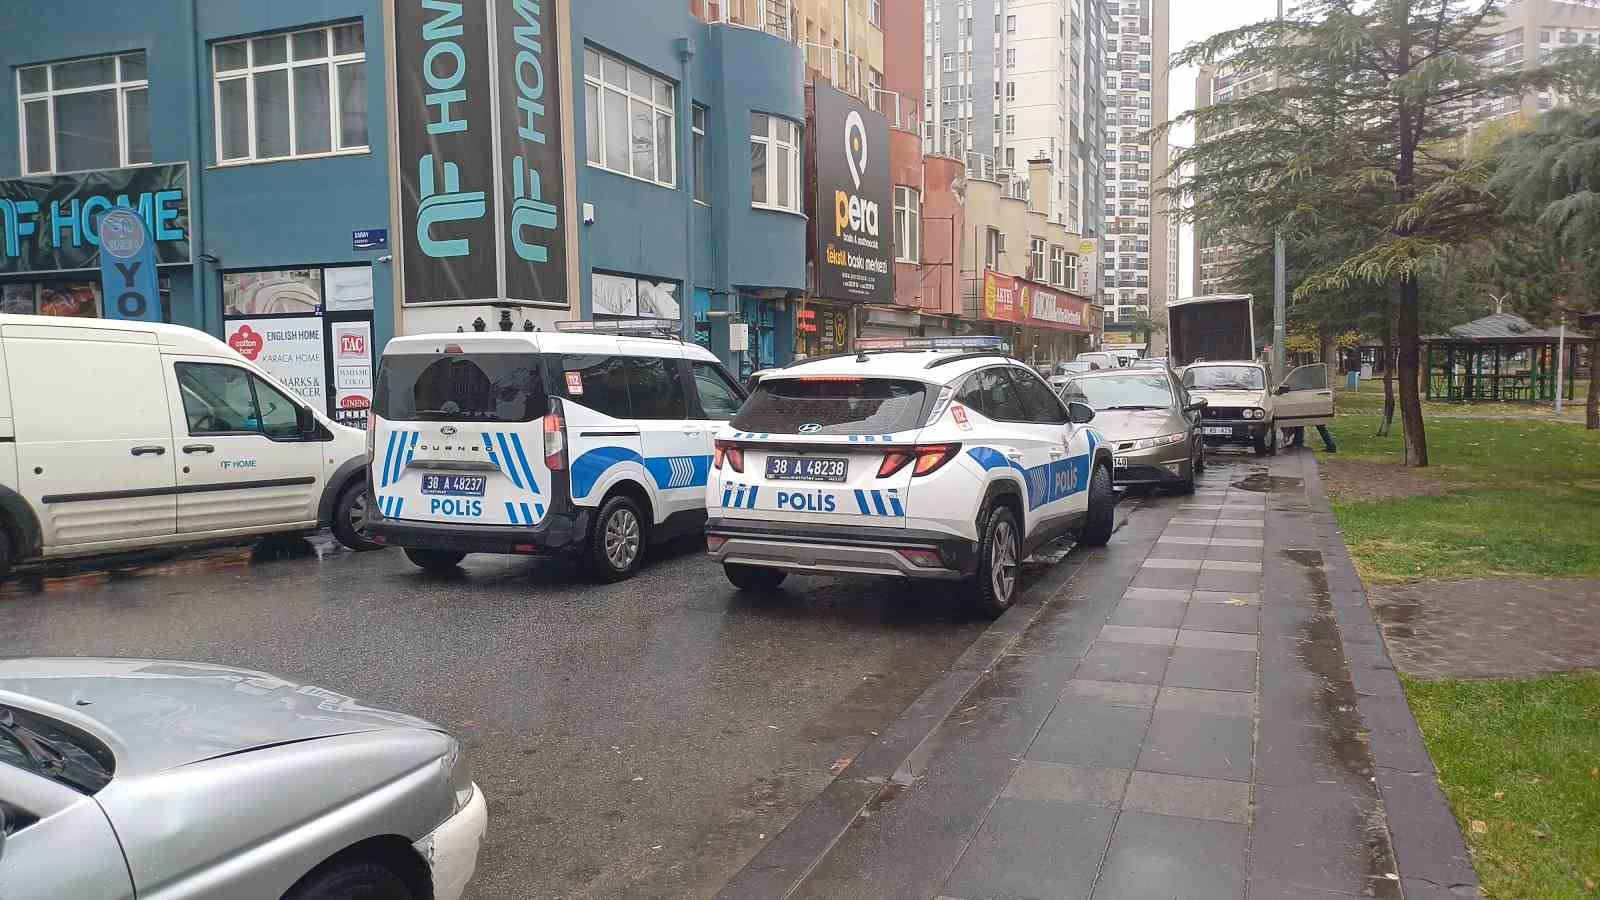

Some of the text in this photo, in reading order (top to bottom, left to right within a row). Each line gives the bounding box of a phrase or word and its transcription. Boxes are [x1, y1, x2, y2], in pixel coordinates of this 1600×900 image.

[422, 0, 468, 134] HOM
[513, 0, 546, 144] HOM
[835, 190, 879, 237] pera
[267, 330, 320, 341] ENGLISH HOME
[342, 337, 364, 352] TAC
[263, 352, 320, 362] KARACA HOME
[280, 376, 312, 387] MARKS
[342, 399, 369, 408] LINENS
[953, 407, 967, 421] 112
[773, 460, 844, 476] 38 A 48238
[427, 476, 482, 491] 38 A 48237
[777, 489, 836, 512] POLİS
